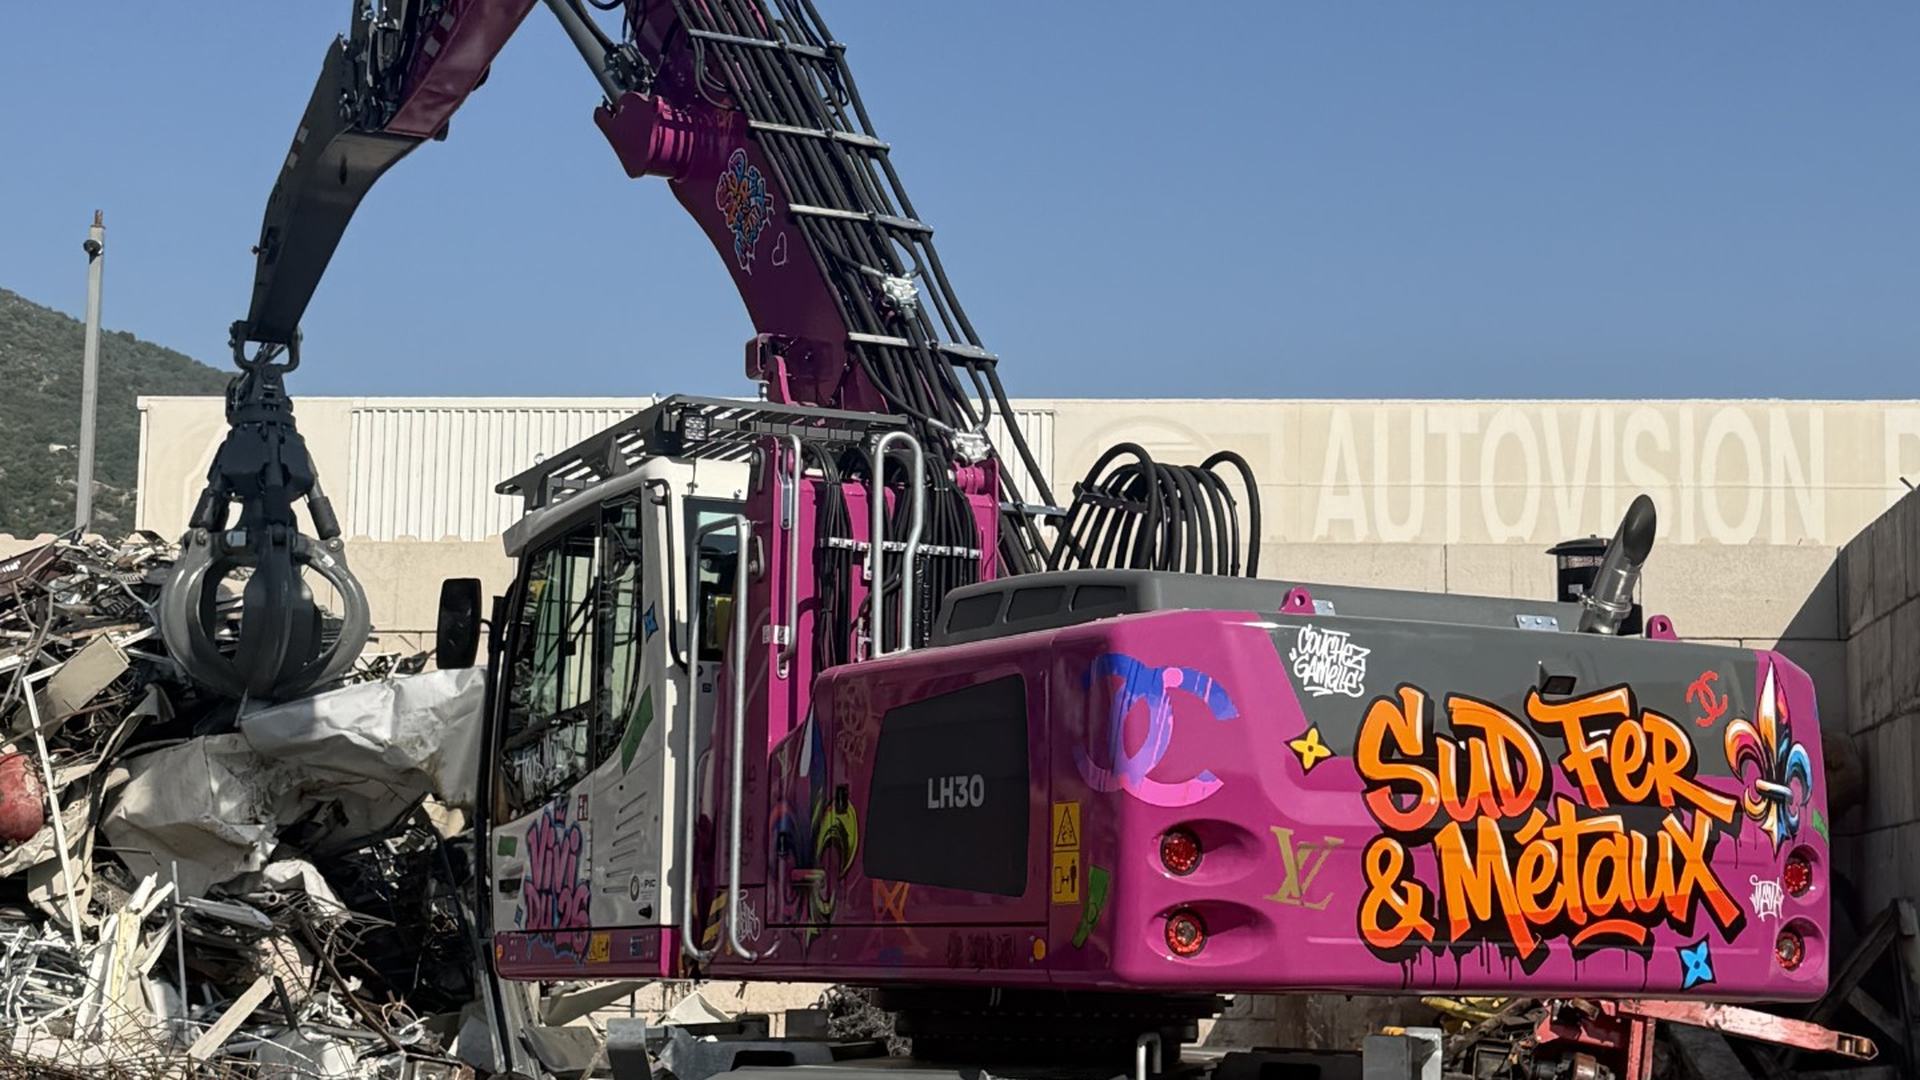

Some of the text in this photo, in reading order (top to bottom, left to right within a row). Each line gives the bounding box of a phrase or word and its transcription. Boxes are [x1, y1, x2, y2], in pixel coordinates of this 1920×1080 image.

[1313, 407, 1824, 544] AUTOVISION
[927, 774, 985, 809] LH30
[1361, 836, 1435, 948] &
